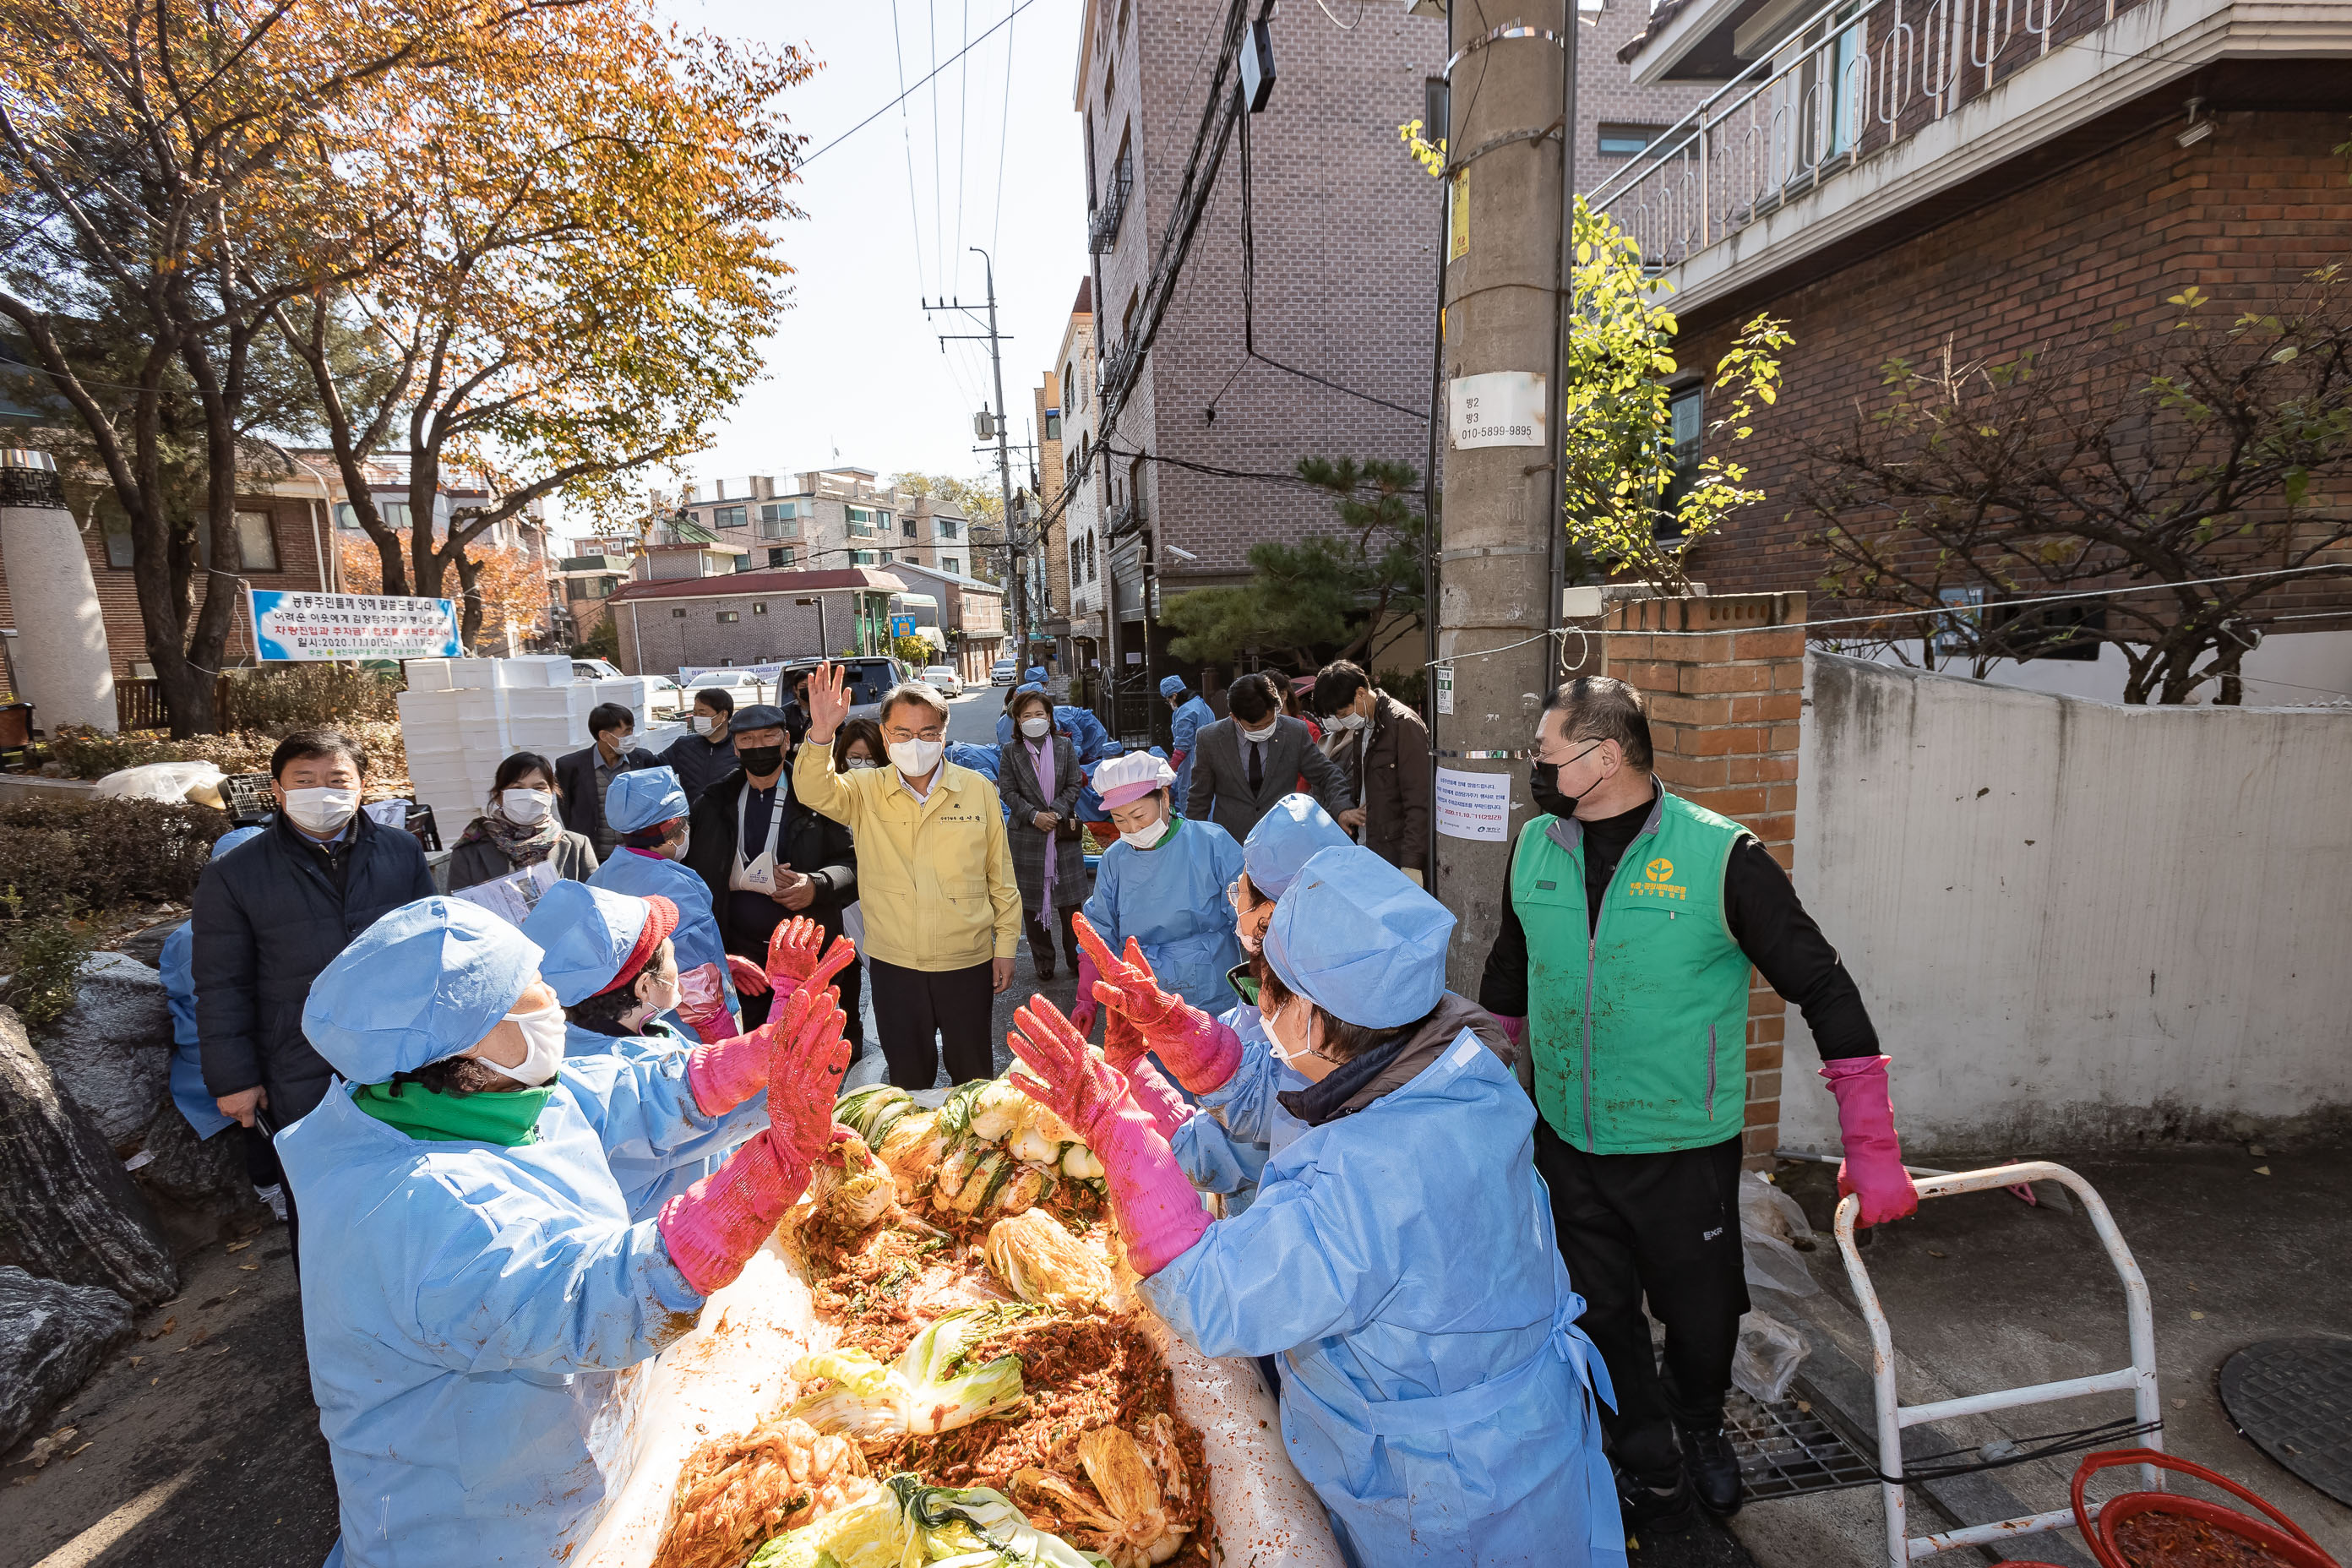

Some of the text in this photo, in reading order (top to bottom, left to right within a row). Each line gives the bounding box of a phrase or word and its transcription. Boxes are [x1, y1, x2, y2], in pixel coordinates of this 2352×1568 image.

[1466, 398, 1479, 408] 방2
[1466, 413, 1478, 424] 방3
[1462, 425, 1532, 439] 010-5899-9895
[292, 596, 435, 612] 능동주민들께 양해 말씀드립니다.
[274, 612, 306, 623] 어려운
[310, 613, 349, 623] 이웃에게
[352, 614, 406, 624] 김장담가주기
[274, 625, 329, 636] 차량진입과
[1703, 1227, 1723, 1241] EXR
